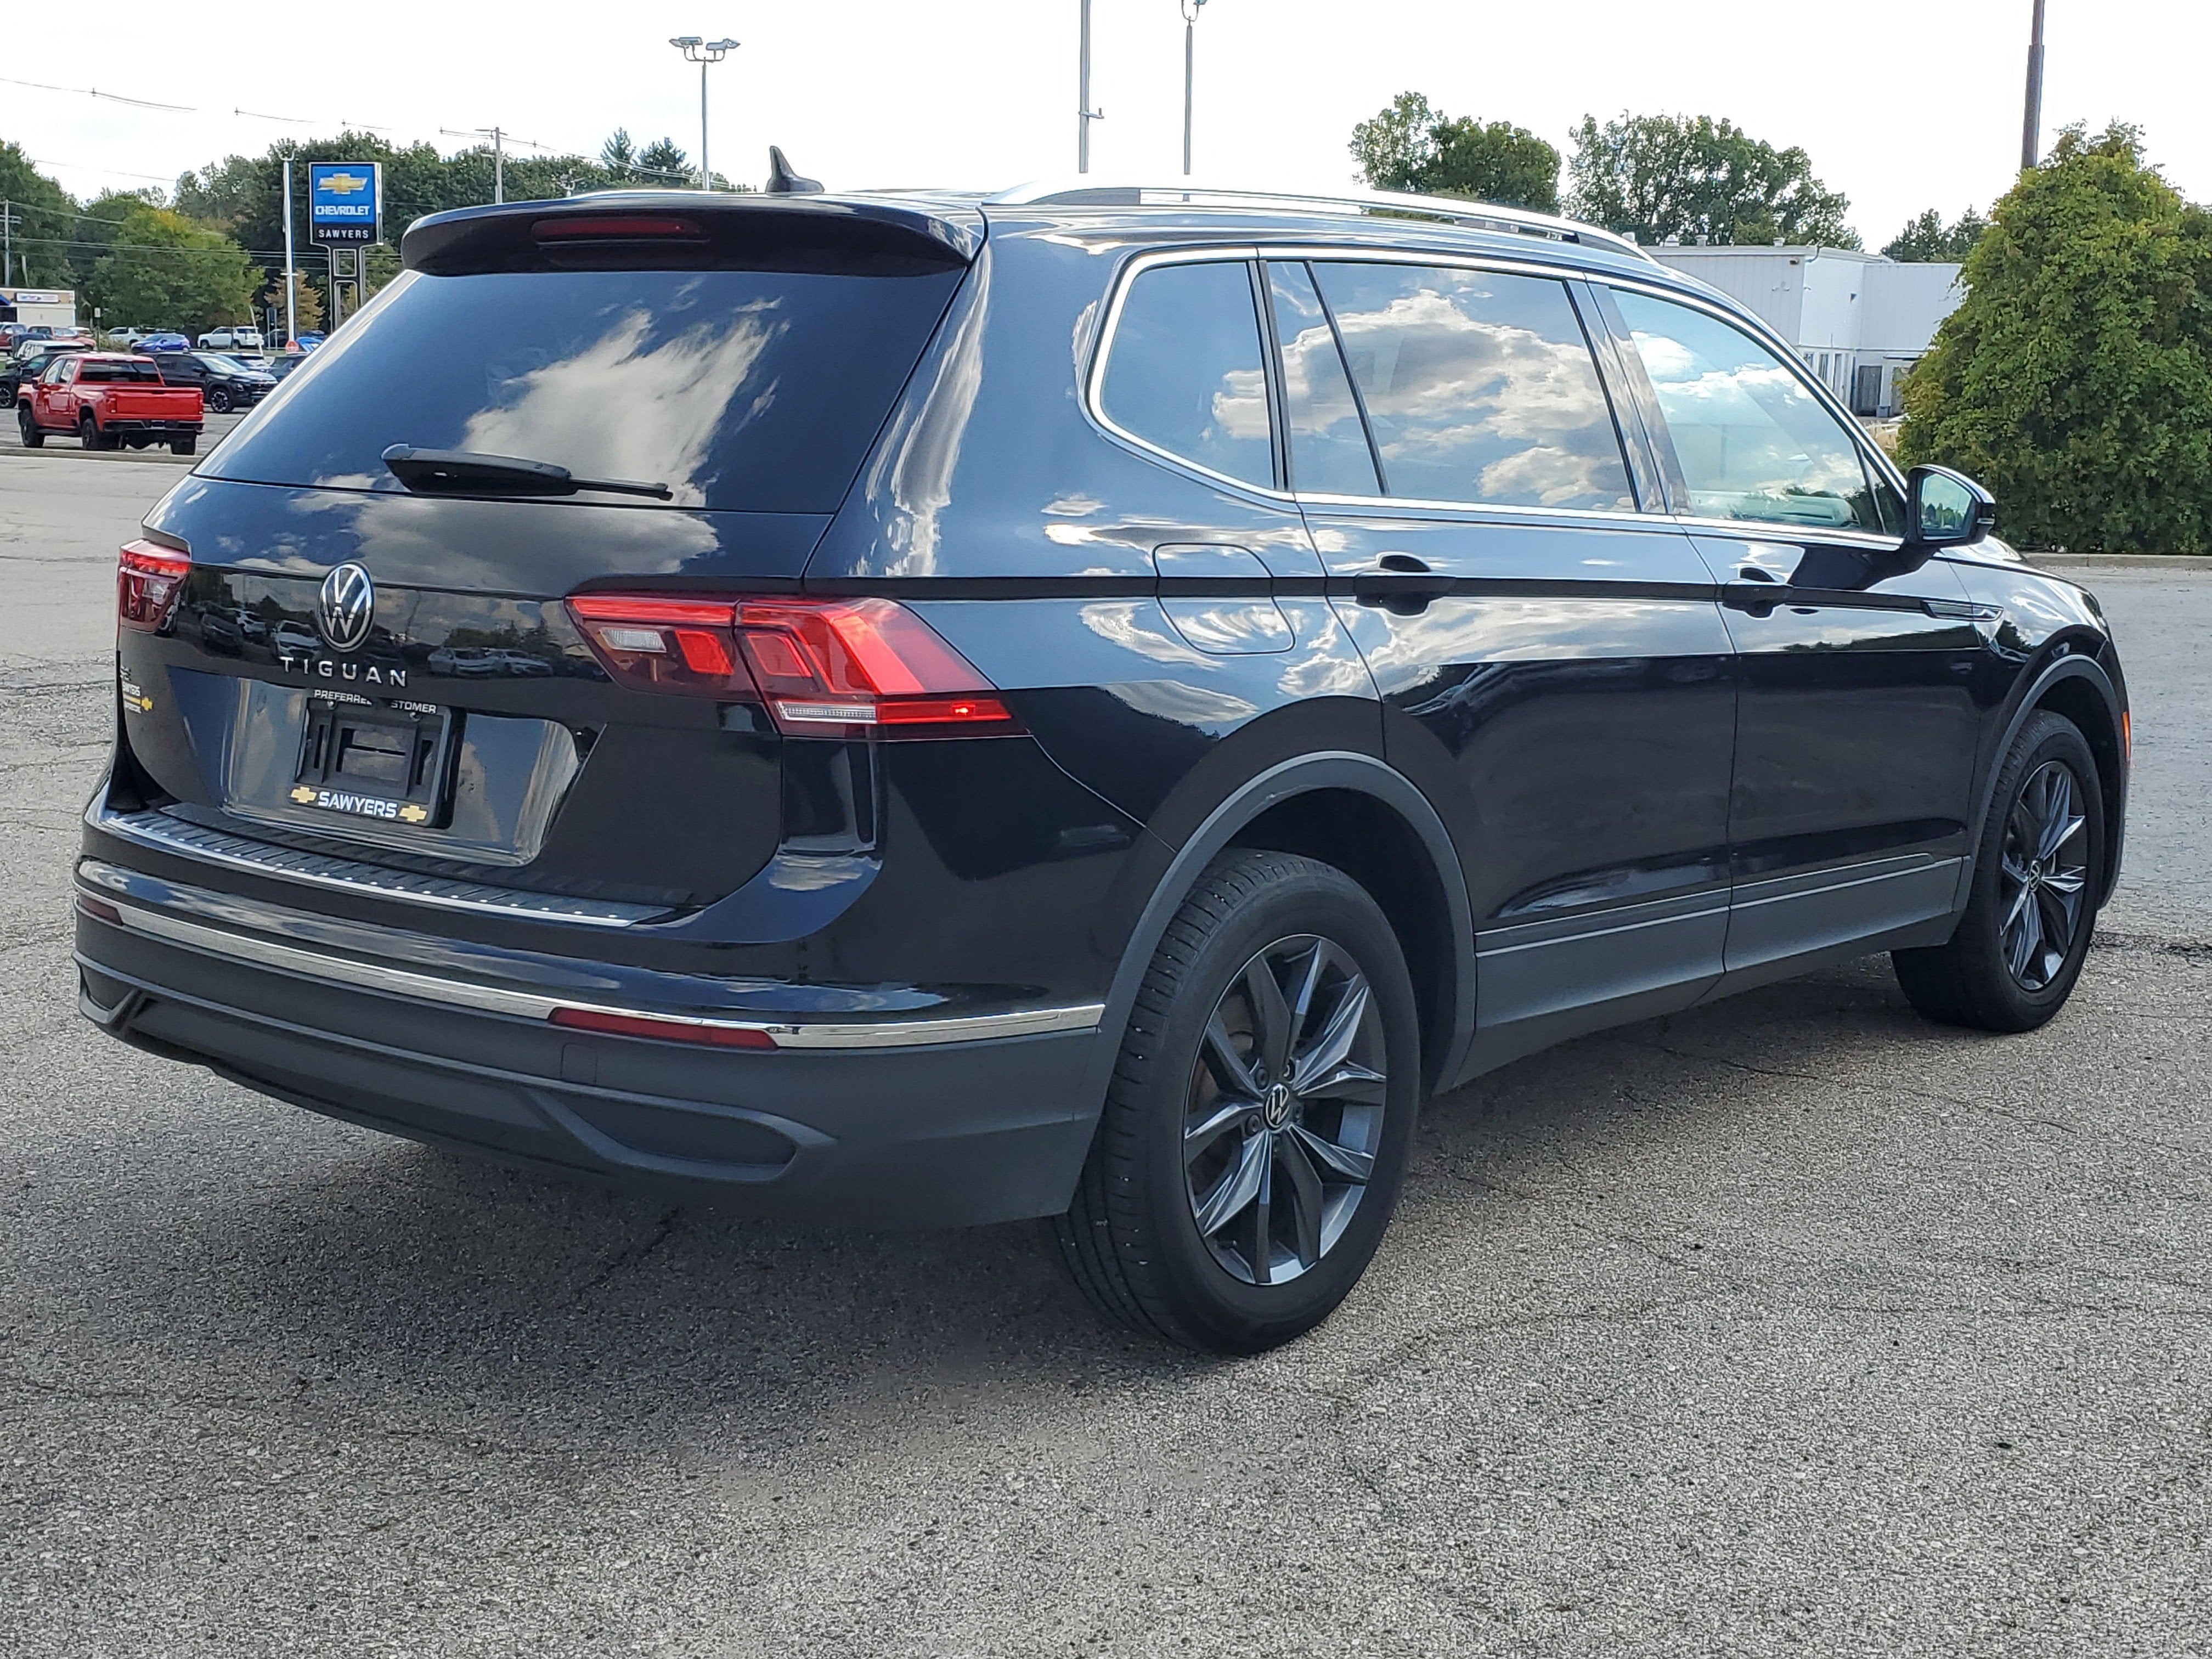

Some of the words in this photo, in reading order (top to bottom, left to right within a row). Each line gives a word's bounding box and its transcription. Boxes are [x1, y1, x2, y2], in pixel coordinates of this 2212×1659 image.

[315, 206, 370, 216] CHEVROLET
[318, 229, 369, 239] SAWYERS
[279, 656, 407, 687] TIGUAN
[390, 699, 437, 714] STOMER
[318, 791, 398, 819] SAWYERS
